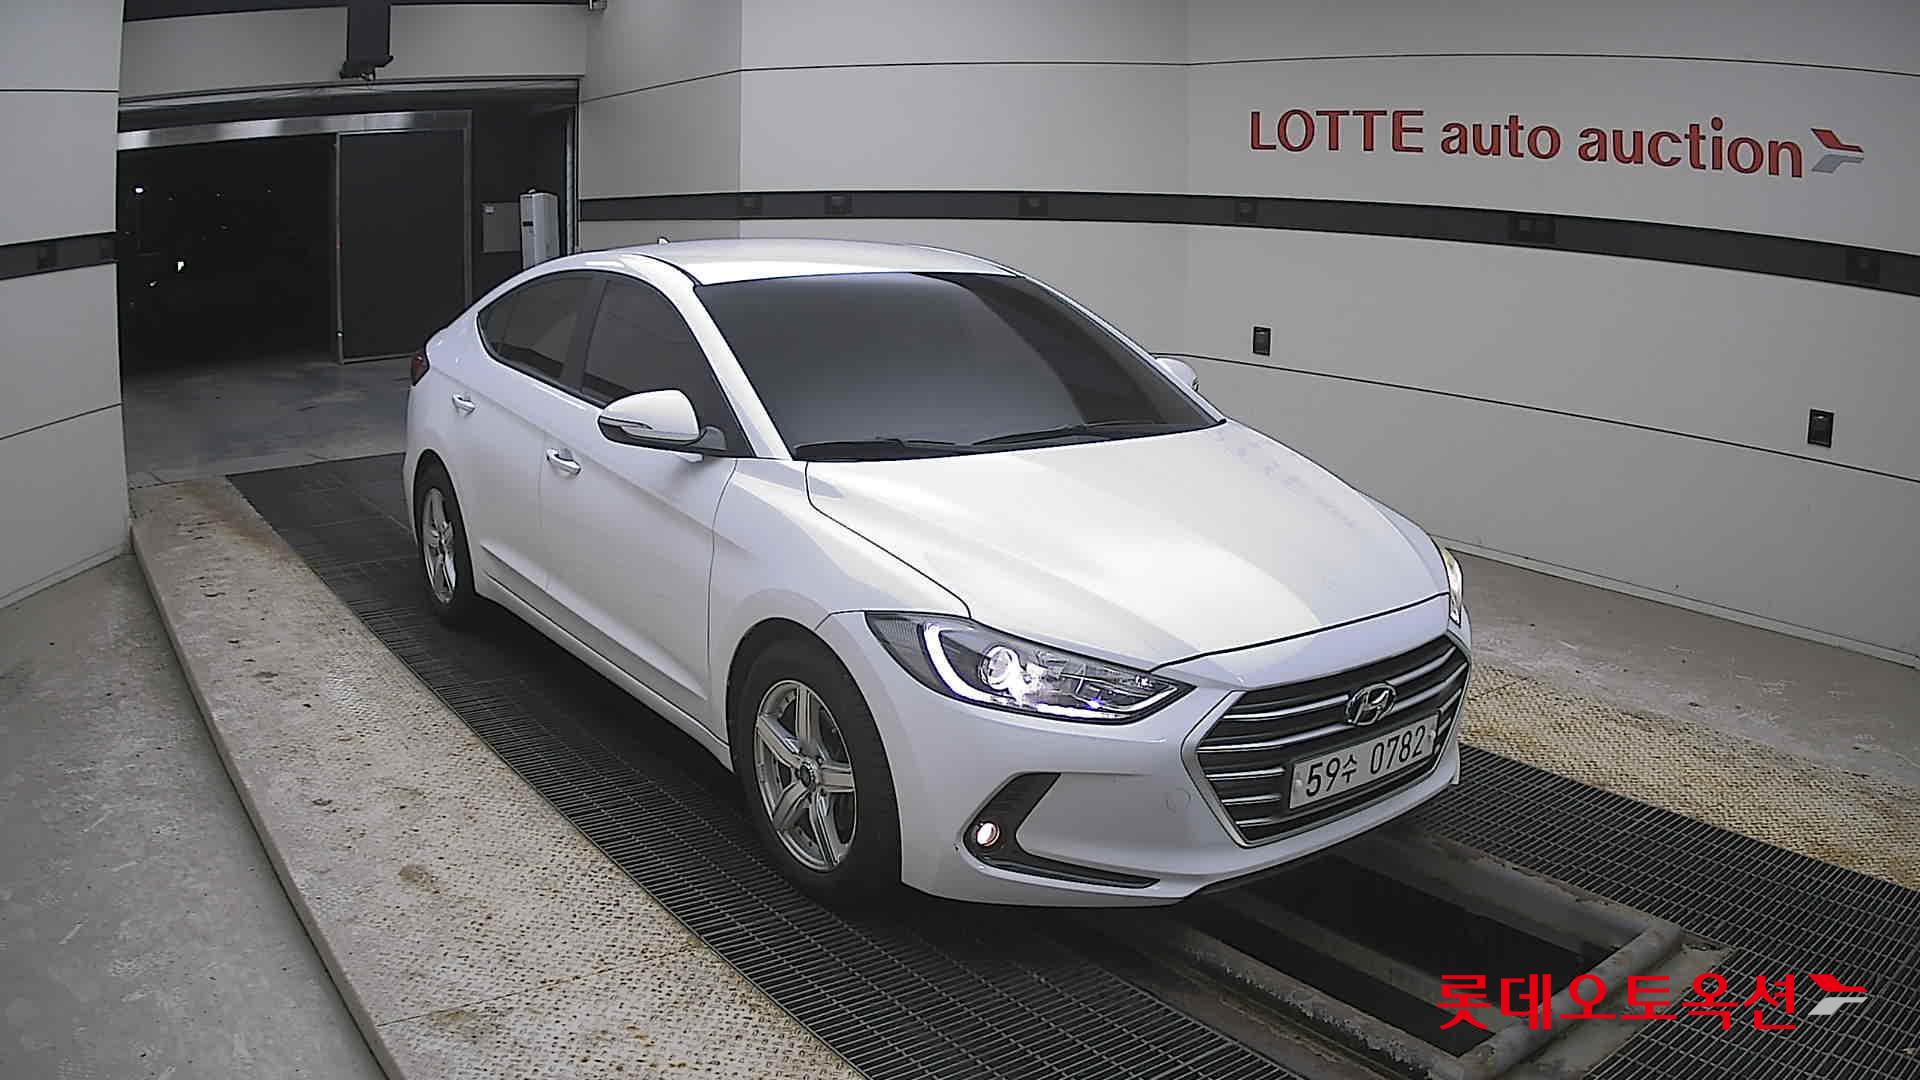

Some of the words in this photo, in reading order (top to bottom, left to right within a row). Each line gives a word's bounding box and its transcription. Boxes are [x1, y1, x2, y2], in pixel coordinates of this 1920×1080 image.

[1249, 109, 1425, 153] LOTTE
[1440, 114, 1561, 159] auto
[1577, 116, 1803, 179] auction
[1306, 754, 1358, 797] 59수
[1370, 725, 1426, 774] 0782
